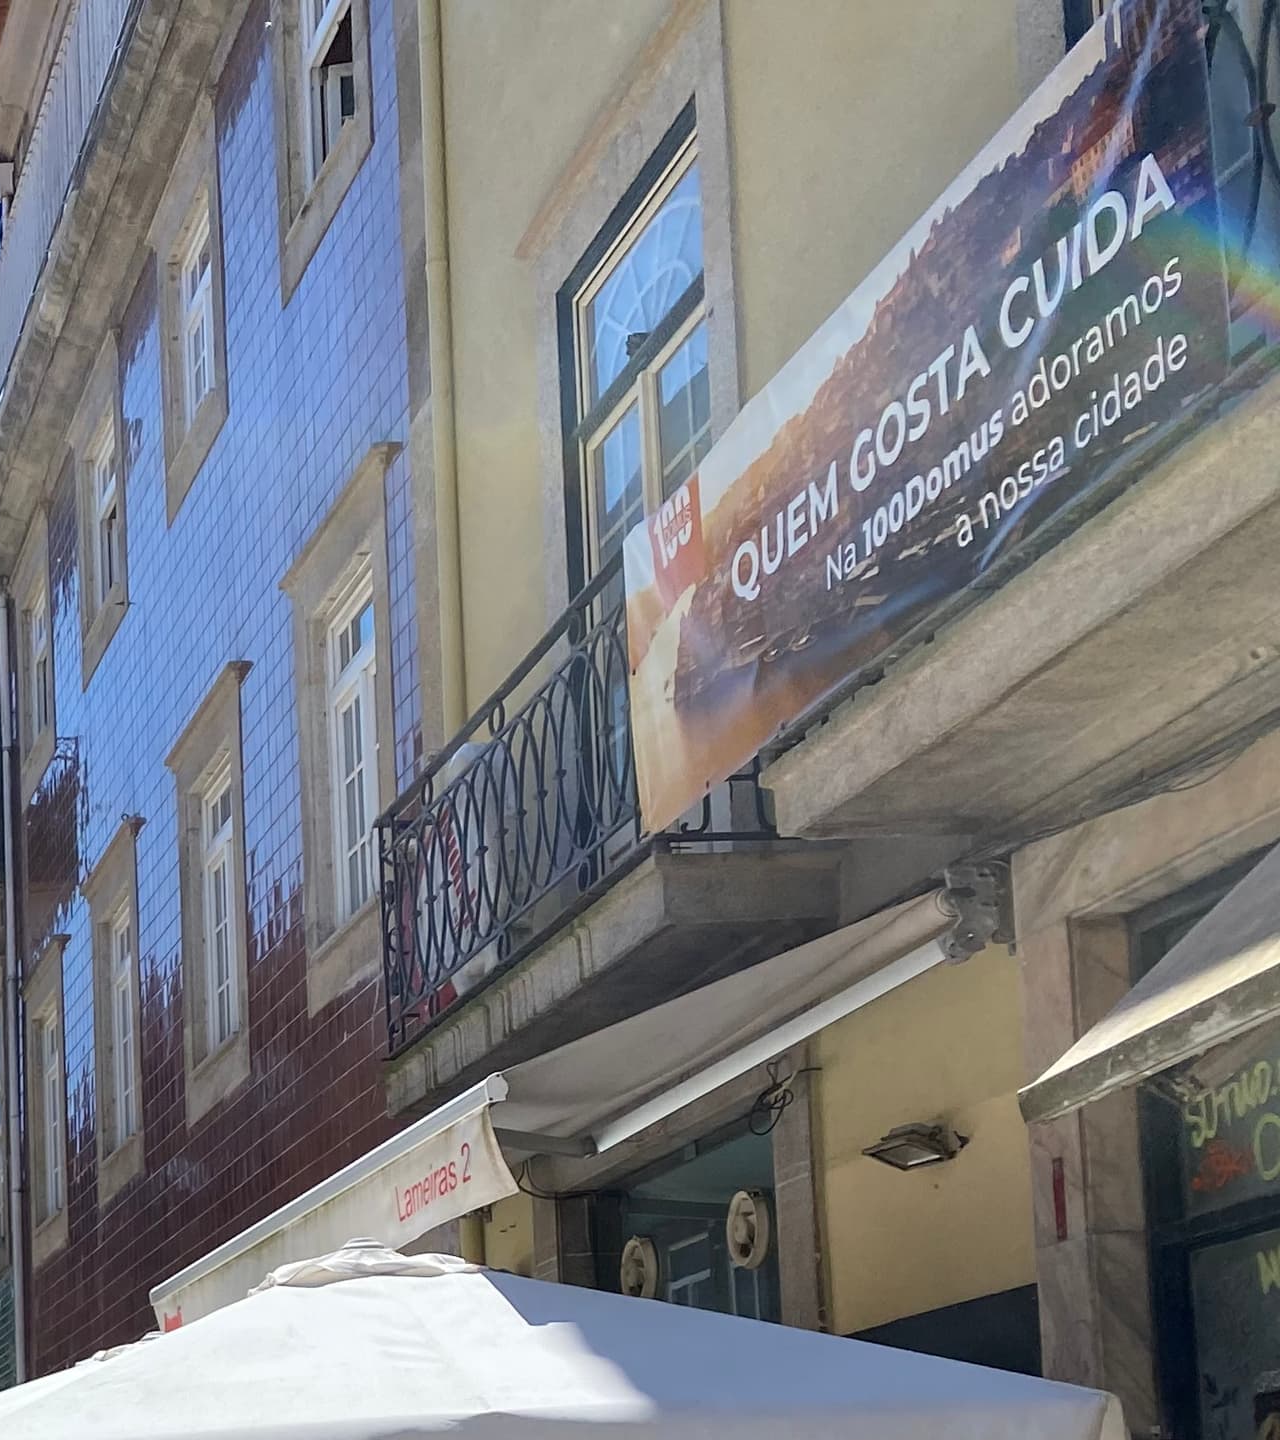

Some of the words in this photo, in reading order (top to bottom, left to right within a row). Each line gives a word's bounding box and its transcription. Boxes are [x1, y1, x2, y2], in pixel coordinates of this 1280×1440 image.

[731, 460, 839, 601] QUEM
[849, 325, 991, 492] GOSTA
[998, 153, 1176, 349] CUIDA
[825, 542, 857, 590] Na
[862, 408, 1004, 557] 100Domus
[1011, 256, 1182, 426] adoramos
[956, 513, 975, 548] a
[979, 435, 1065, 529] nossa
[1074, 333, 1188, 449] cidade
[395, 1161, 458, 1222] Lameiras
[460, 1142, 472, 1183] 2
